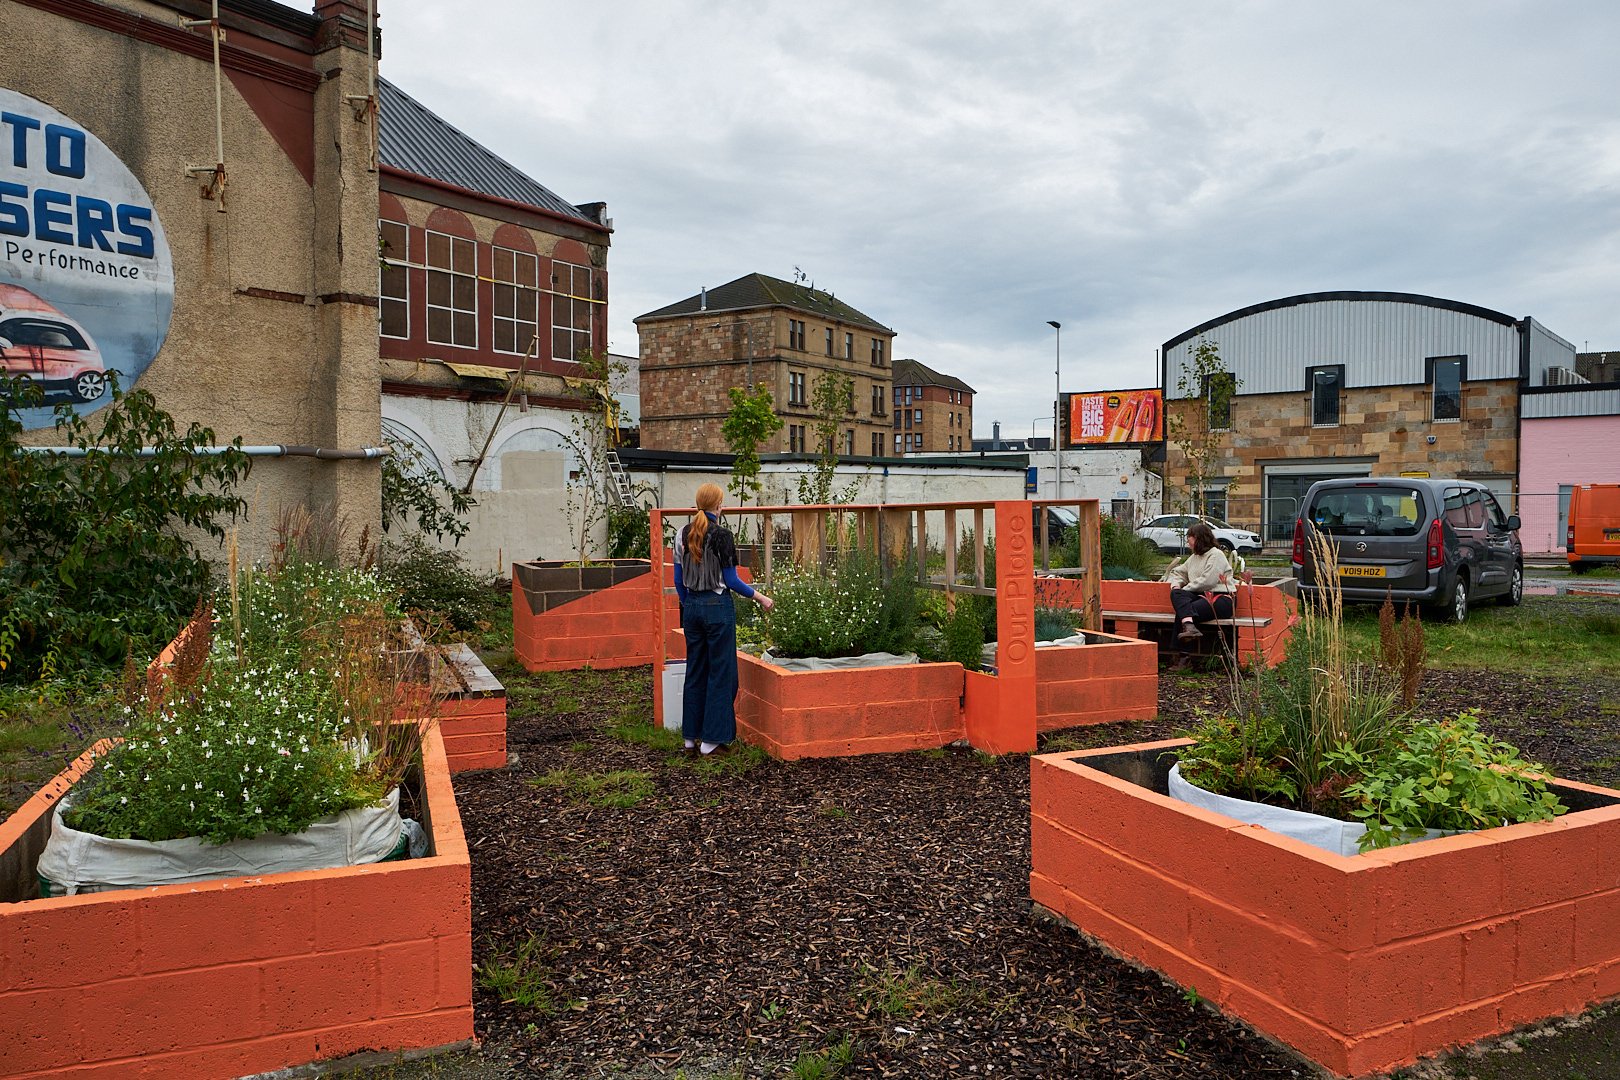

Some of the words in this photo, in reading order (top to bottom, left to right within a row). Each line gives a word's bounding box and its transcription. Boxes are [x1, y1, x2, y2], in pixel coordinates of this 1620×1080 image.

[1, 111, 86, 180] TO
[0, 181, 155, 260] SERS
[6, 241, 139, 280] Performance
[1081, 396, 1104, 405] TASTE
[1082, 409, 1104, 425] BIG
[1081, 425, 1104, 437] ZING
[1004, 514, 1027, 600] Place
[1343, 567, 1362, 575] VO19
[1363, 568, 1381, 576] HDZ
[1006, 606, 1028, 665] Our
